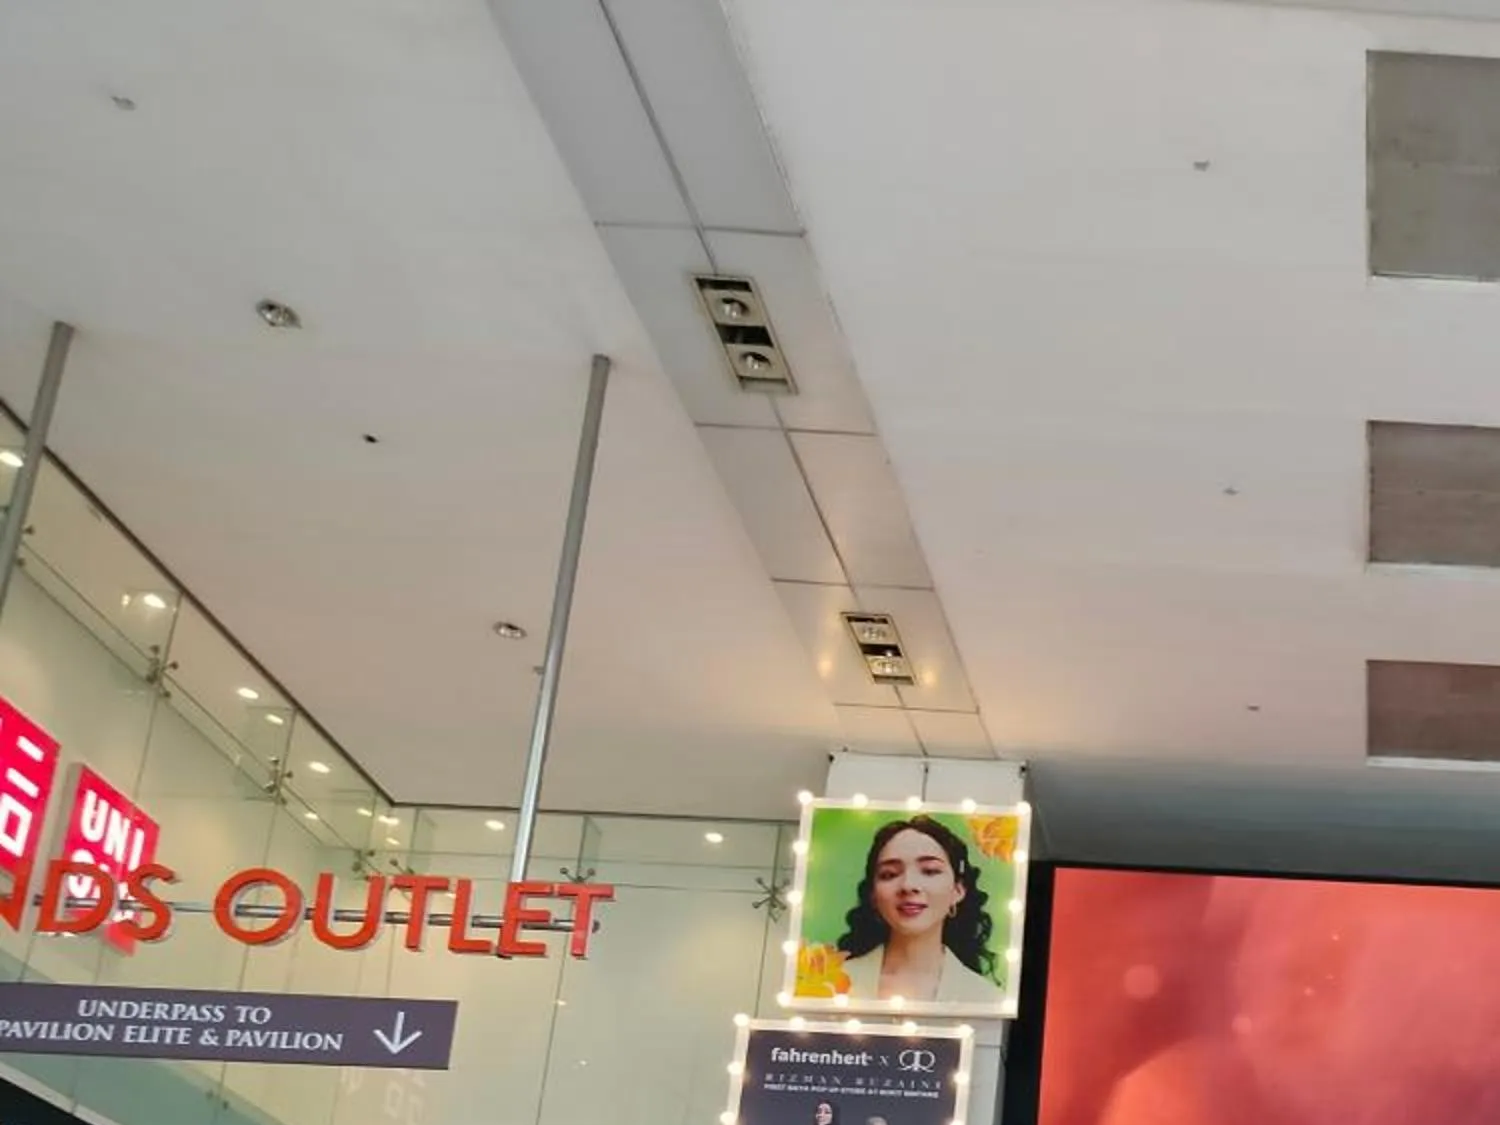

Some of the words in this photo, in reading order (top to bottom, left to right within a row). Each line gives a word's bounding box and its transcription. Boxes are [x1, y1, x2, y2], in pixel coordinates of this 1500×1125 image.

[80, 789, 145, 872] UNI
[212, 867, 616, 960] OUTLET
[77, 999, 226, 1023] UNDERPASS
[235, 1005, 271, 1024] TO
[0, 1019, 114, 1042] PAVILION
[123, 1025, 192, 1045] ELITE
[199, 1028, 219, 1046] &
[226, 1030, 343, 1051] PAVILION
[771, 1047, 868, 1067] fahrenheit
